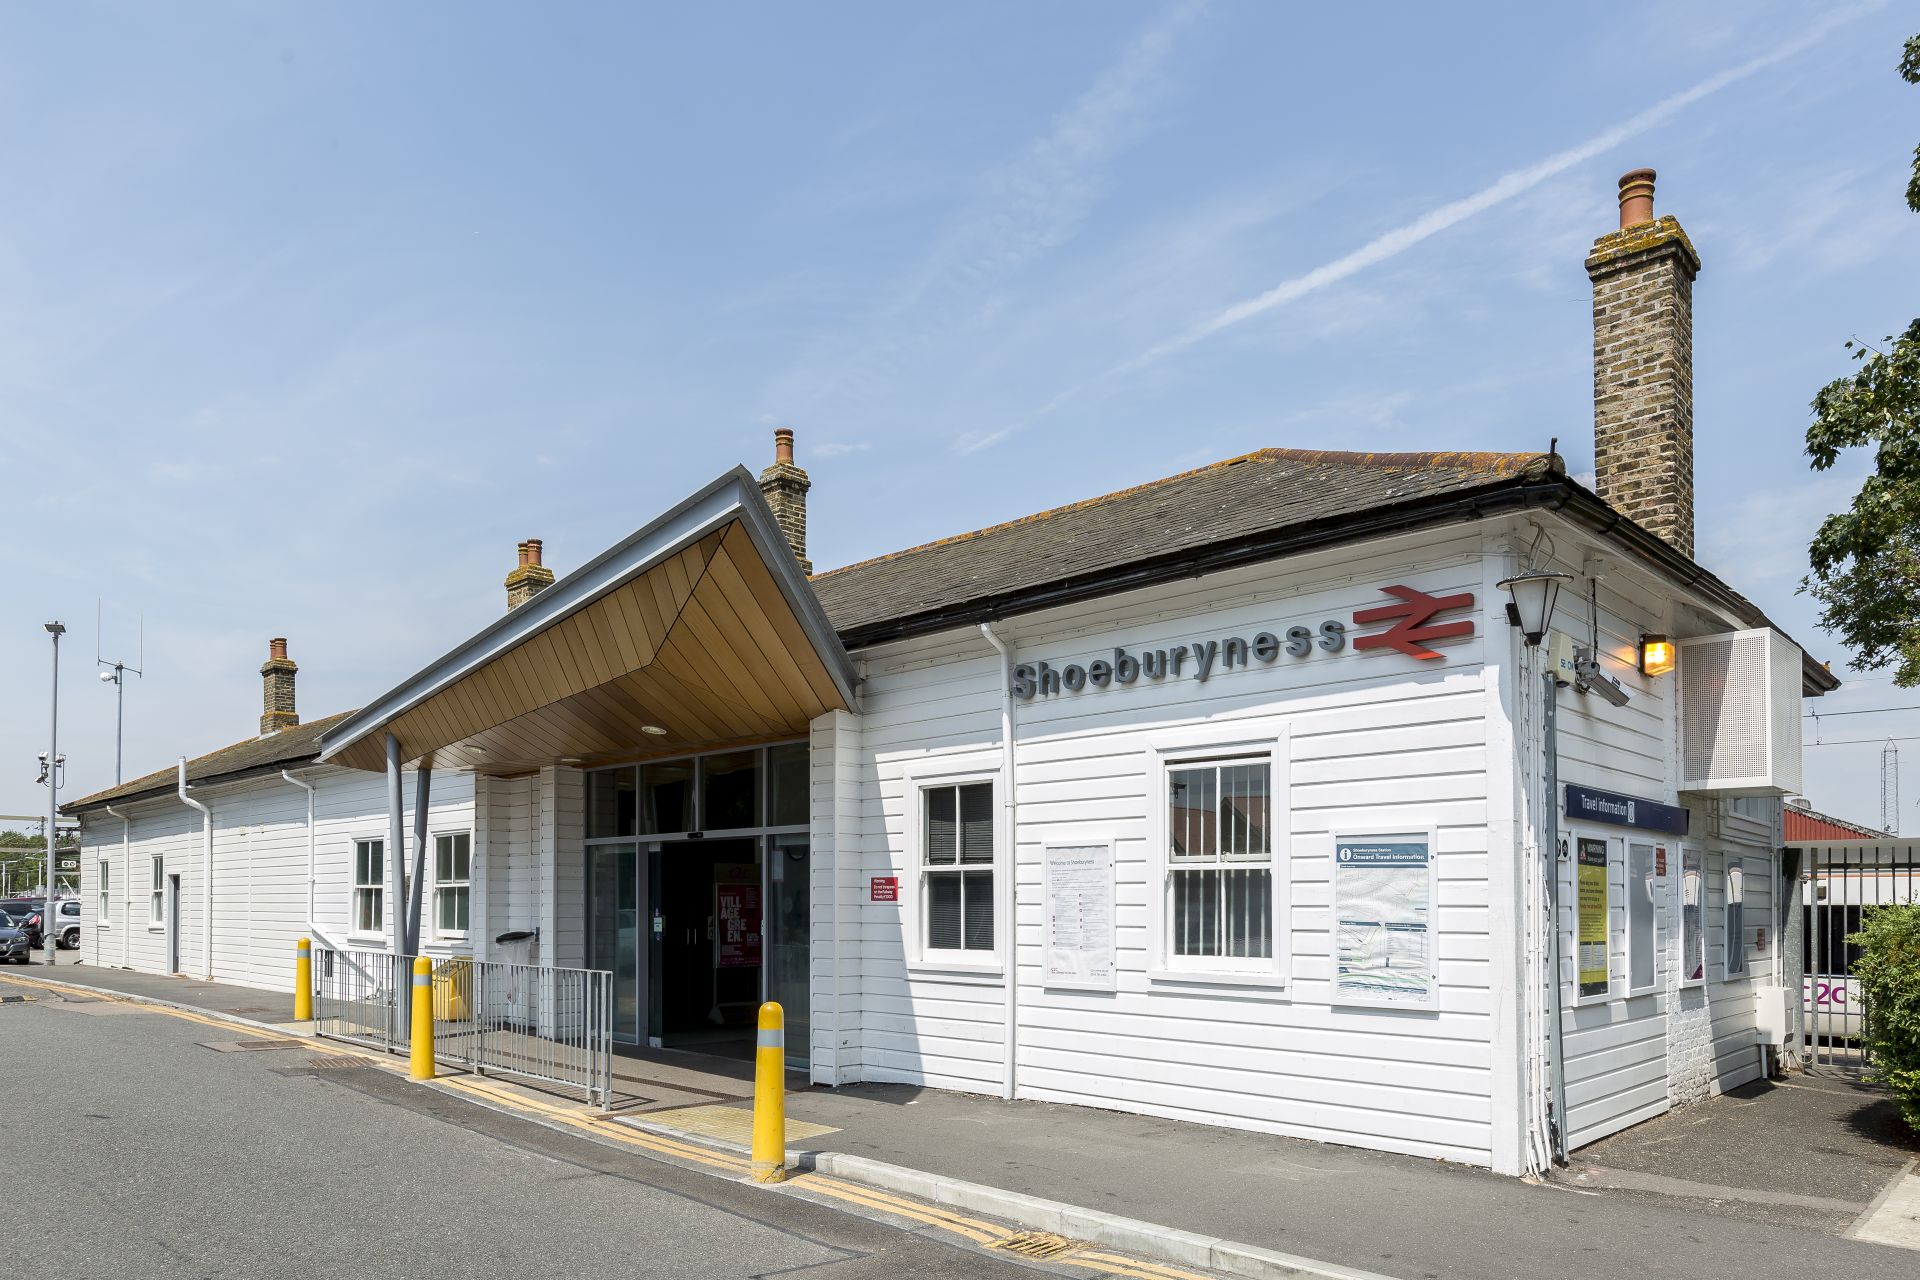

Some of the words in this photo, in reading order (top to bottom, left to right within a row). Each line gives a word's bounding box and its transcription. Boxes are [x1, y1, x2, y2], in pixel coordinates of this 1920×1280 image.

[1011, 620, 1346, 699] Shoeburyness
[1581, 794, 1598, 811] Travel
[1598, 797, 1628, 816] information
[720, 896, 742, 908] VILL
[720, 908, 740, 920] AGE
[728, 920, 746, 930] GRE
[728, 930, 743, 942] EN.
